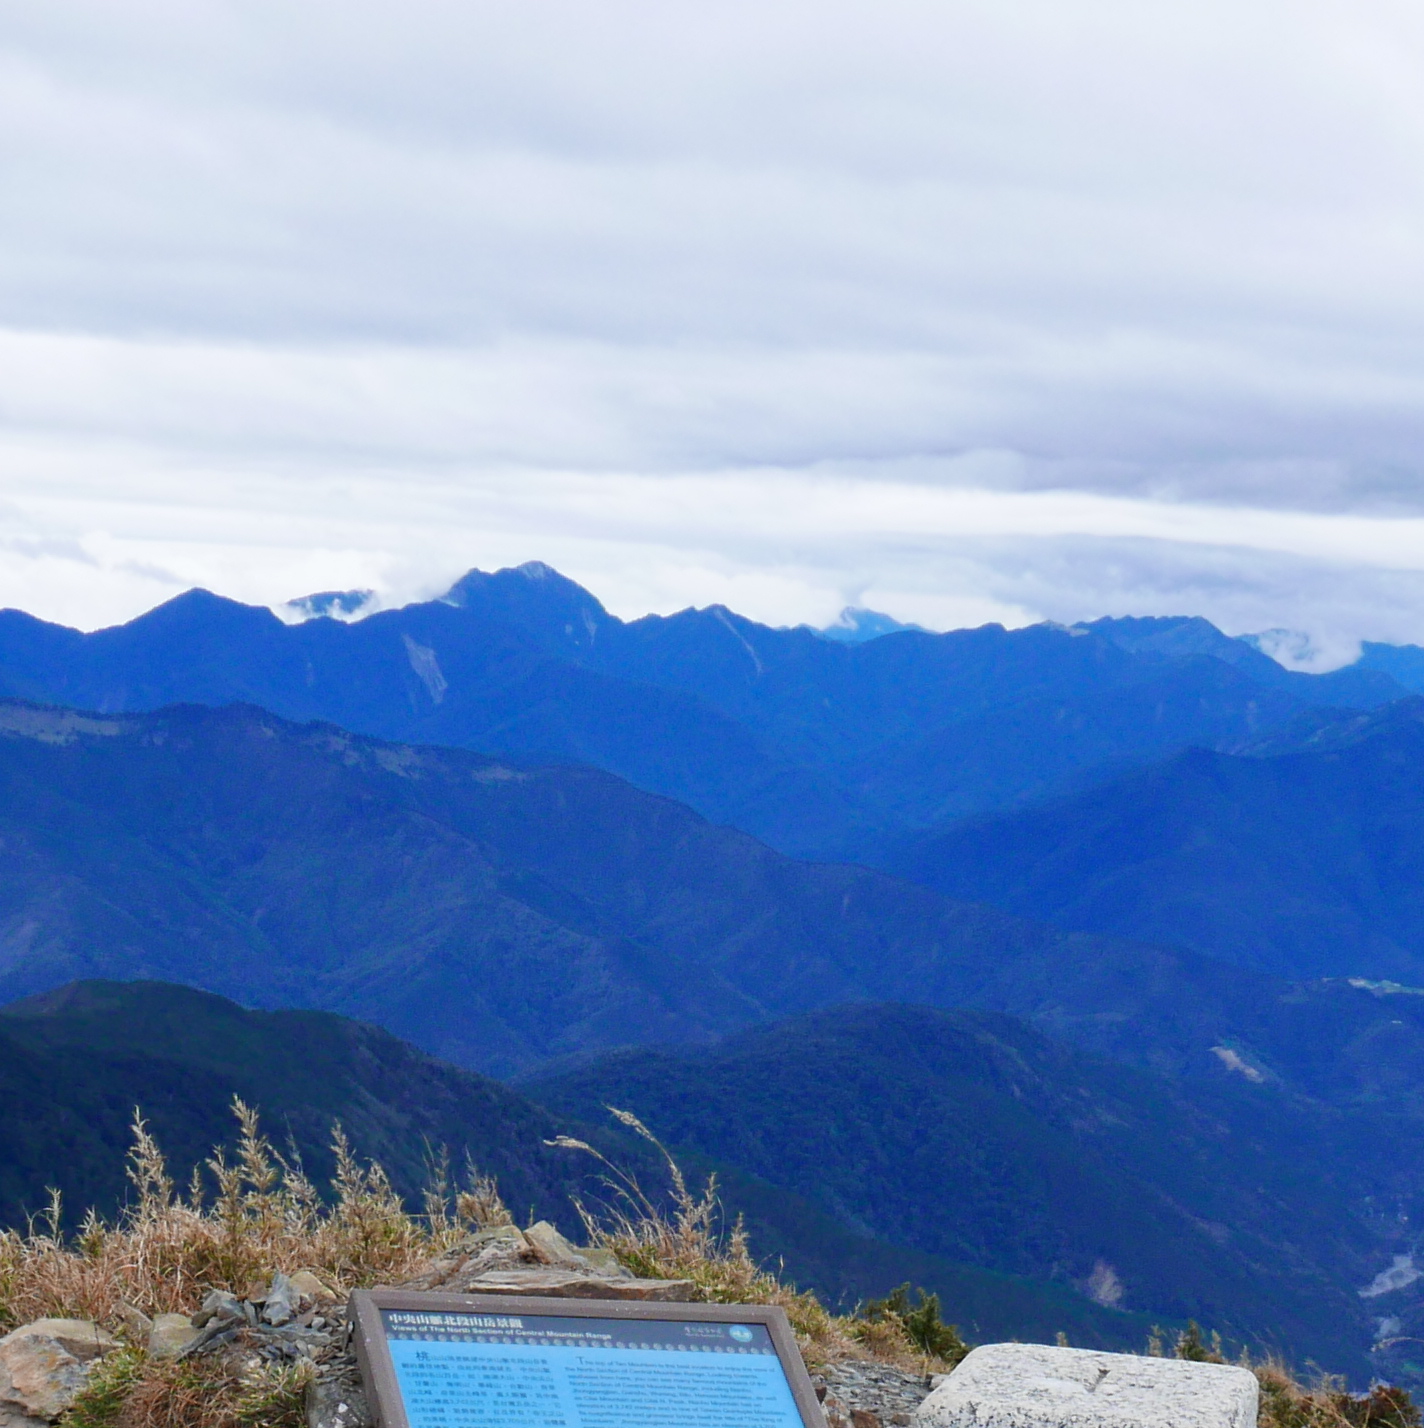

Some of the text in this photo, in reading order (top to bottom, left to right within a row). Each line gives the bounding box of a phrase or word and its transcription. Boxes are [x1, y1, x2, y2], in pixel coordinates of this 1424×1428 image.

[473, 1327, 504, 1335] Section
[515, 1329, 544, 1337] Central
[585, 1332, 612, 1340] Range
